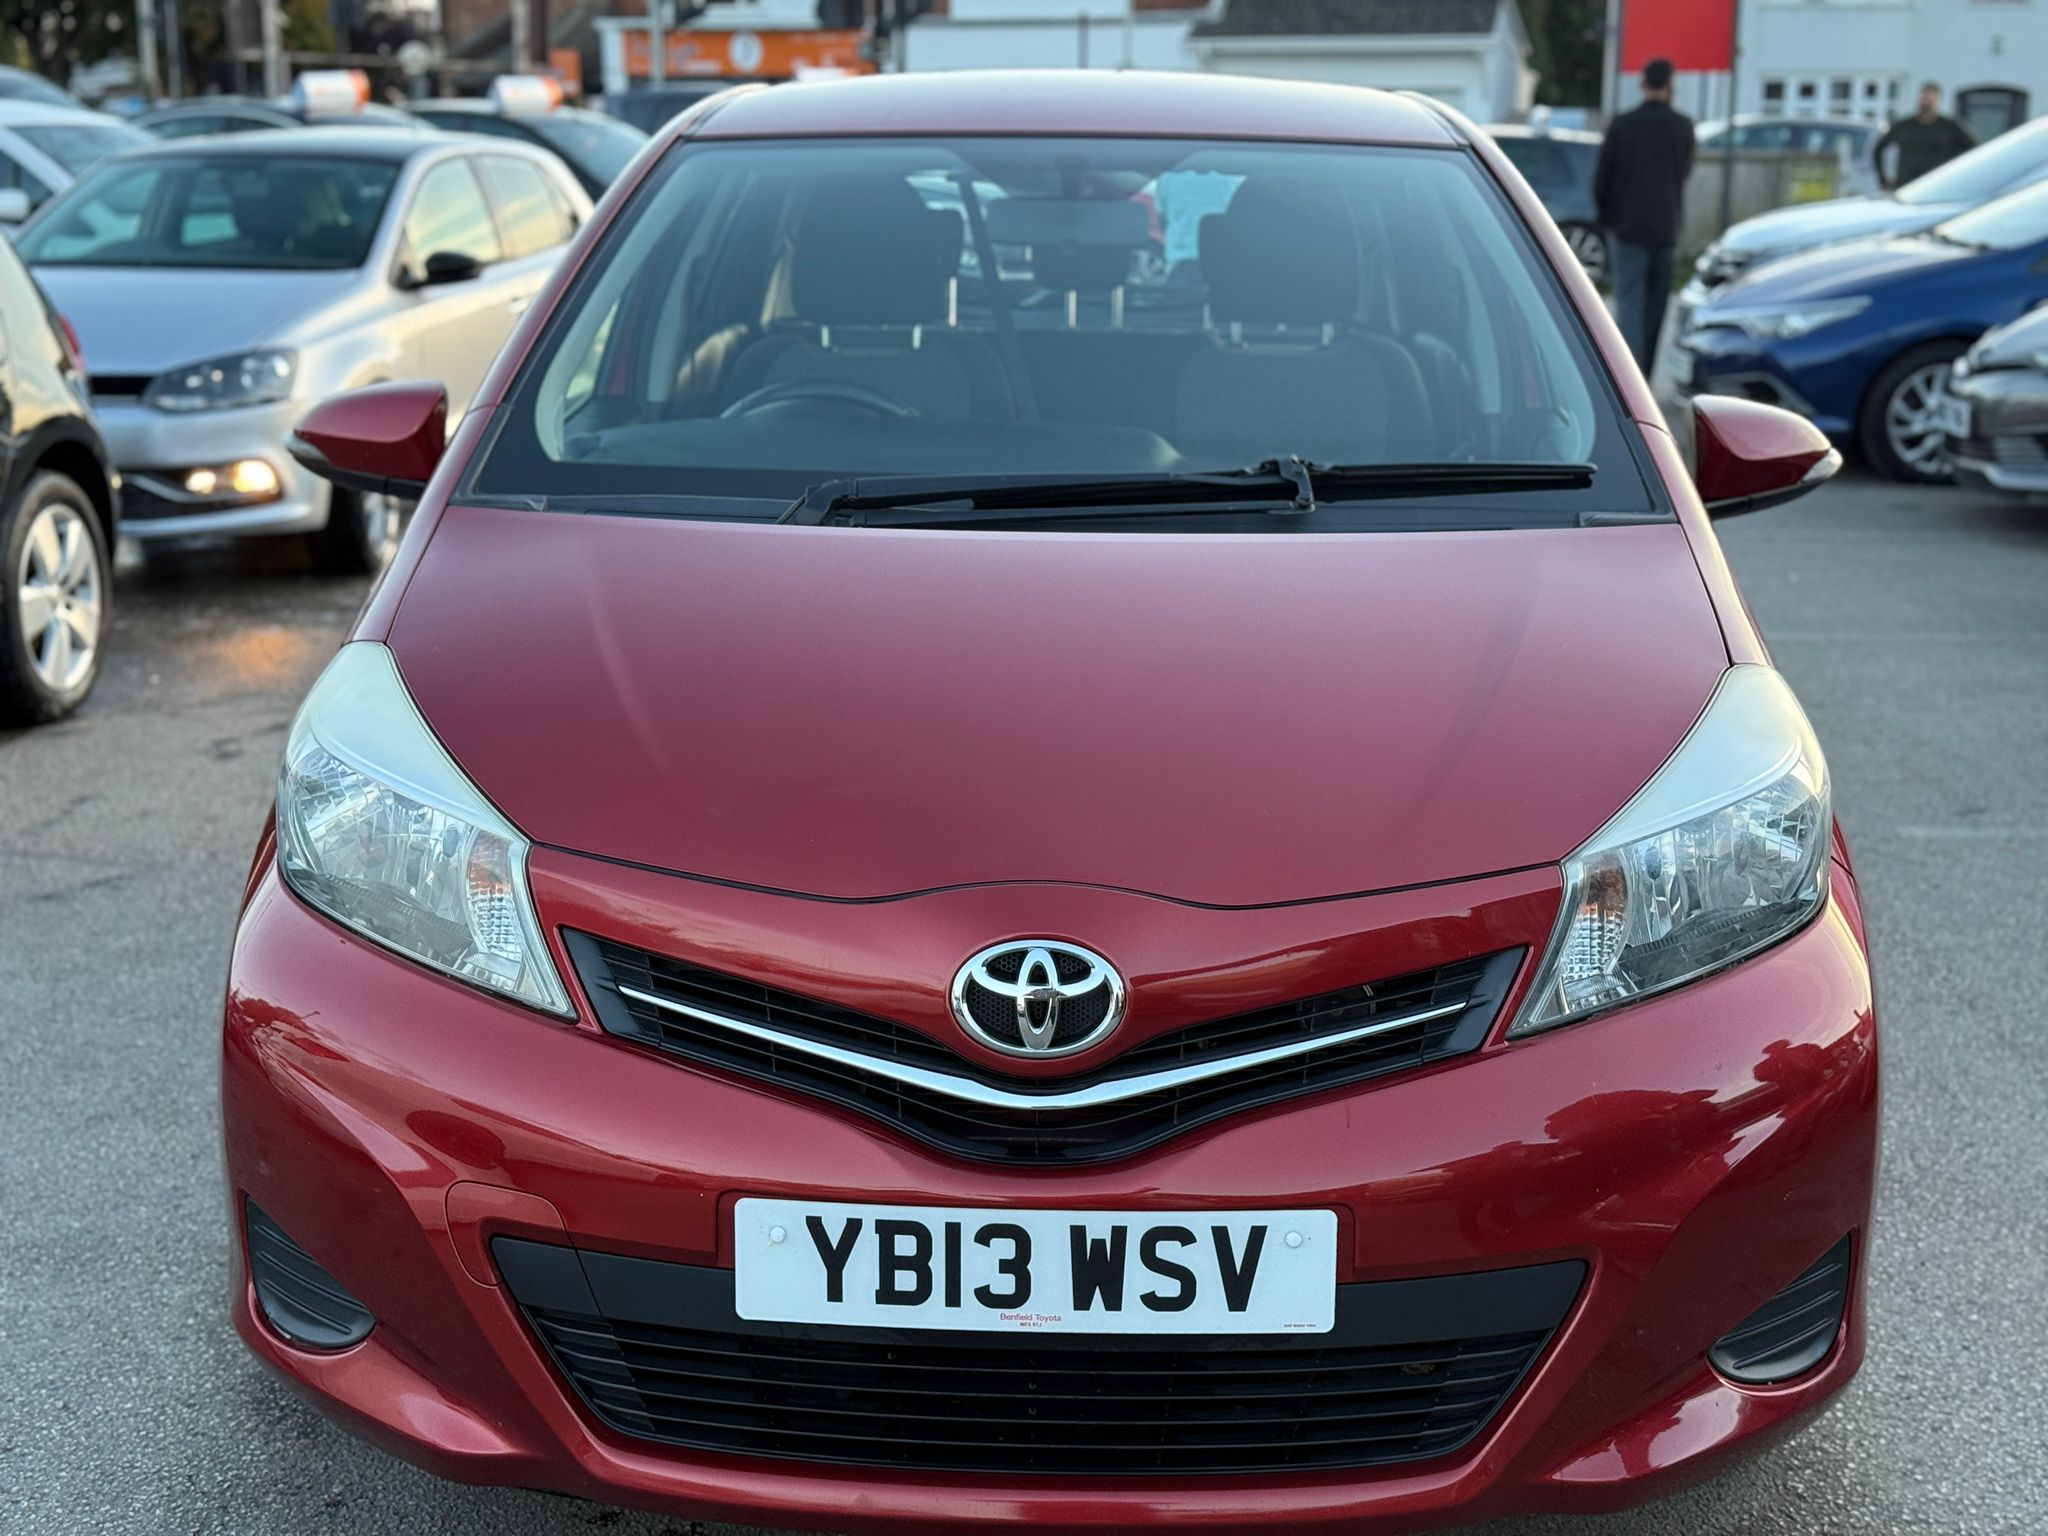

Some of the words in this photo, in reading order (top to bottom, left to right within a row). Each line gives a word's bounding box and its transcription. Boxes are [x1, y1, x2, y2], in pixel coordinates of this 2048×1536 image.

[805, 1215, 1032, 1310] YB13
[1069, 1224, 1268, 1312] WSV
[1000, 1312, 1033, 1321] Benfield
[1035, 1313, 1062, 1323] Toyota
